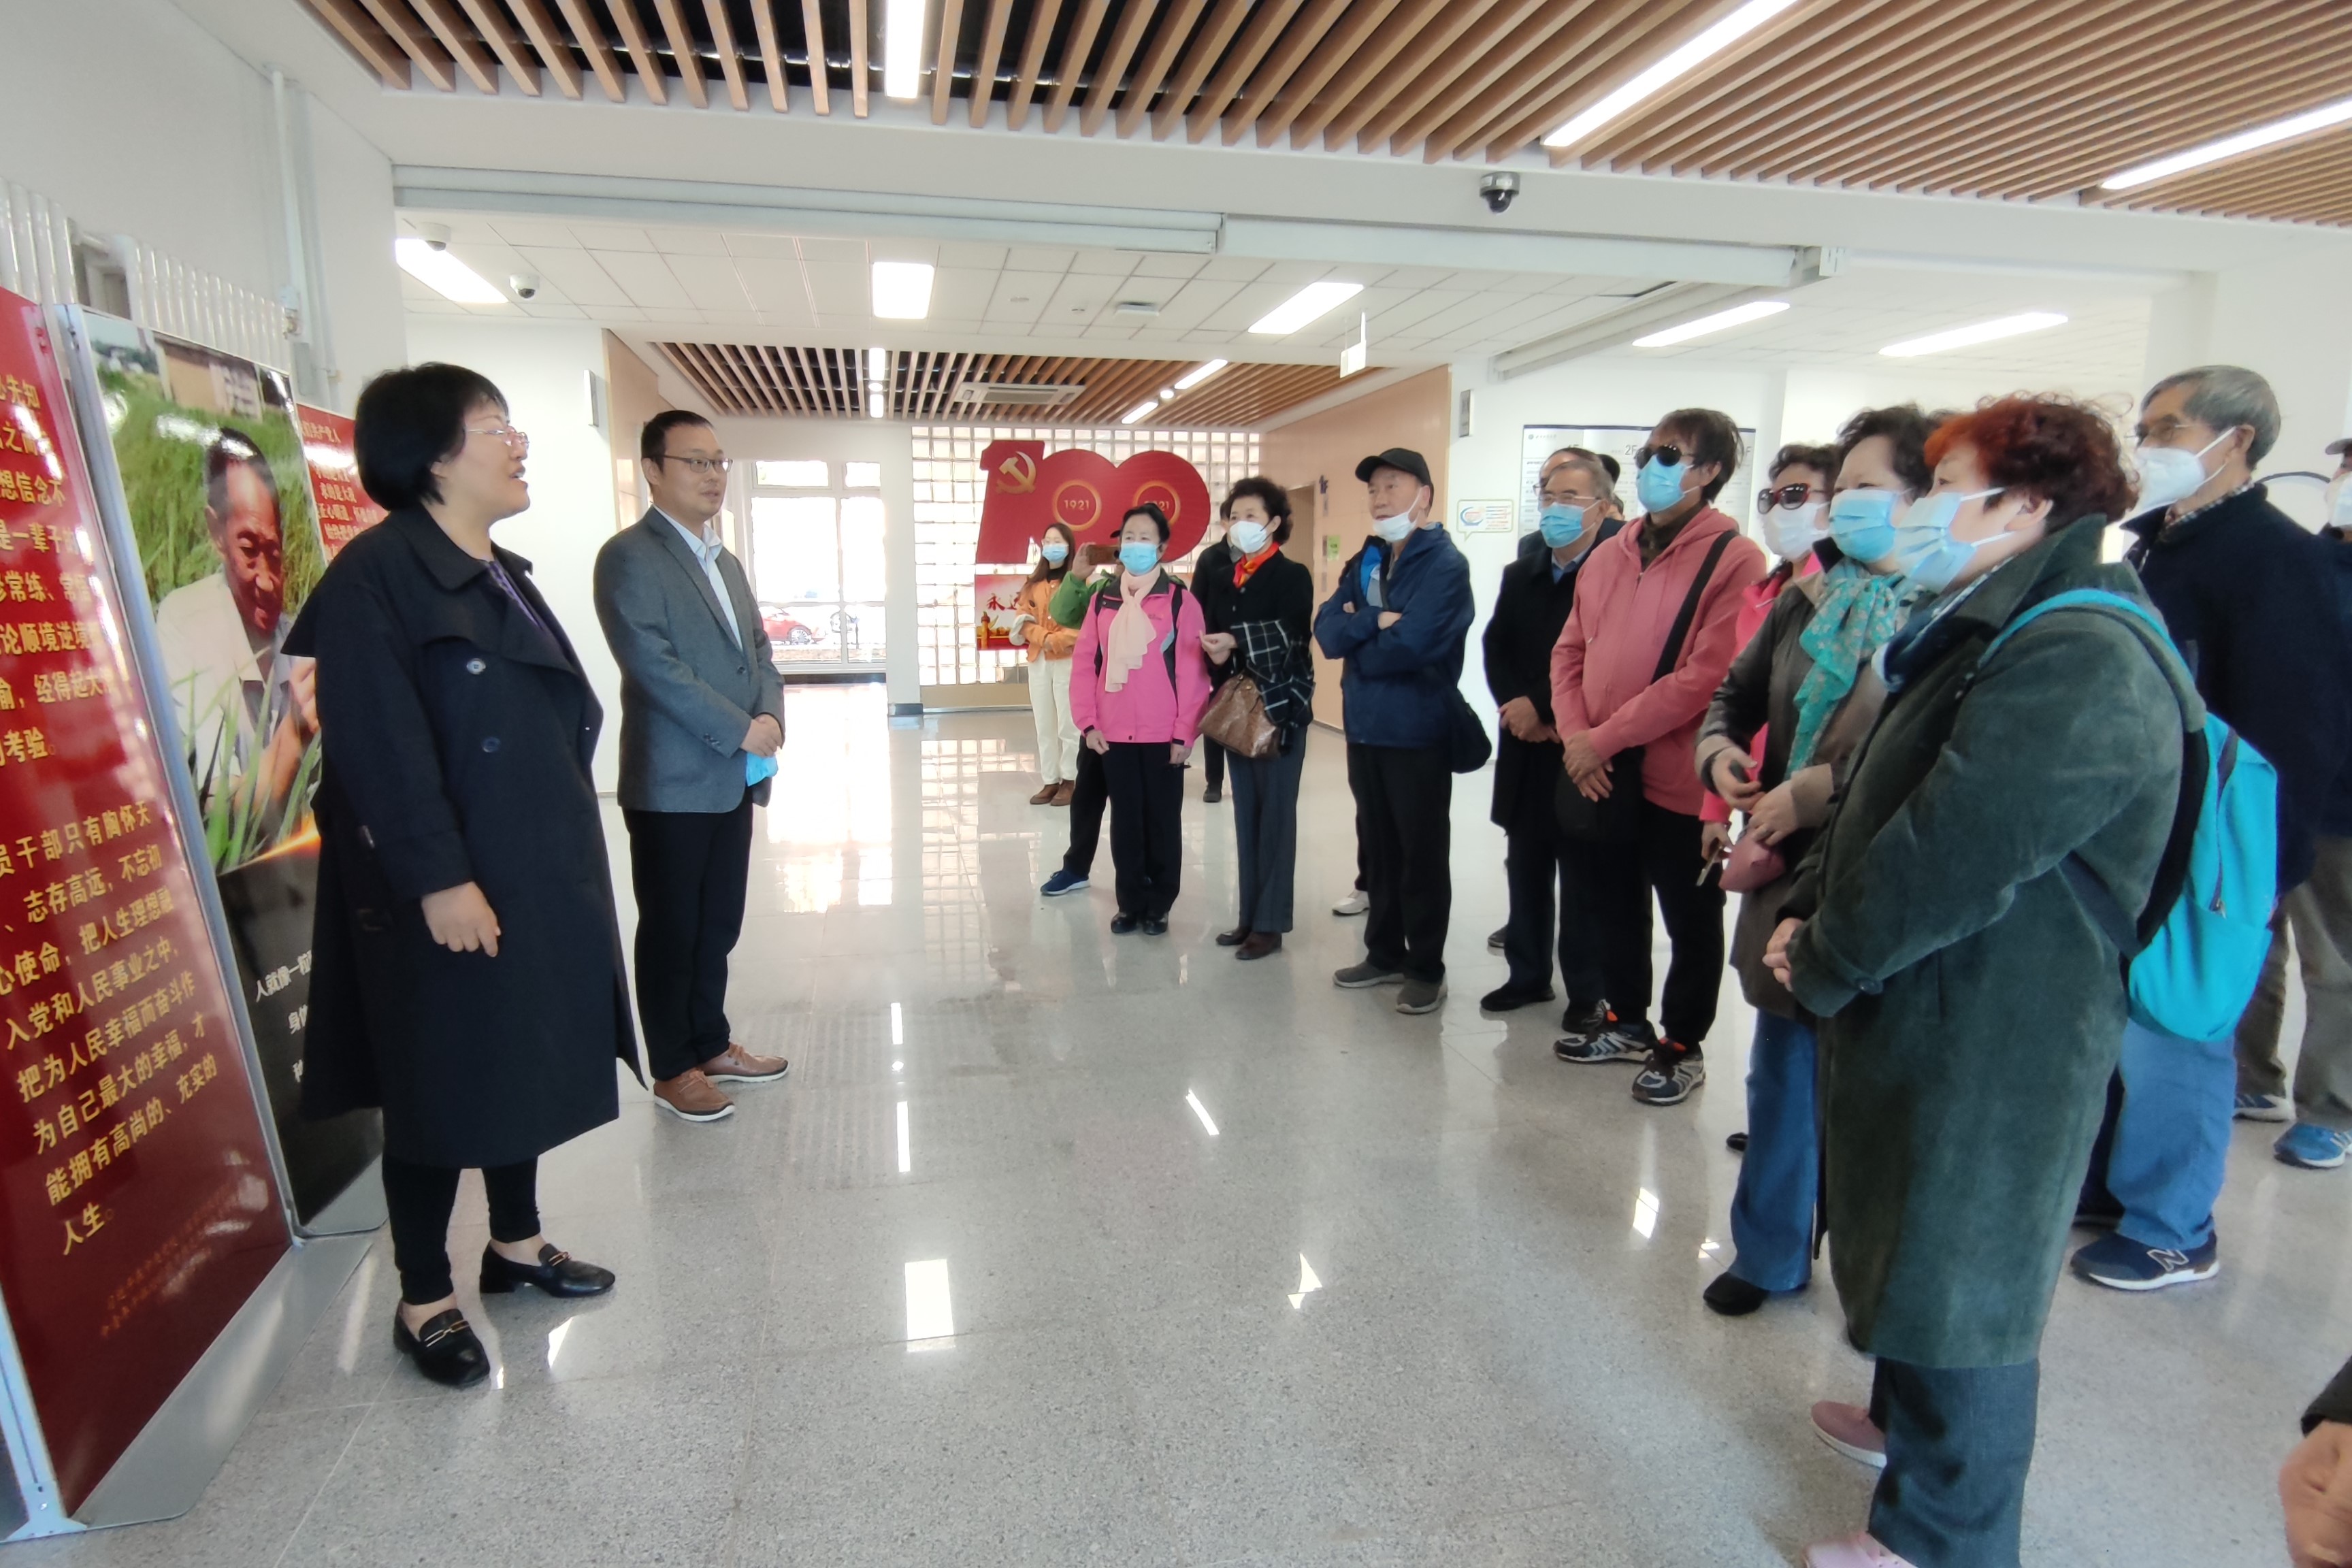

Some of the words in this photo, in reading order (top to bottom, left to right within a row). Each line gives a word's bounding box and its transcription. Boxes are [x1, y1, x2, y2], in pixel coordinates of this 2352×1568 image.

[1064, 500, 1090, 510] 1921
[0, 621, 102, 655] 论顺境逆境
[0, 726, 55, 763] 考验。
[17, 970, 196, 1104] 把为人民幸福而奋斗作
[46, 1053, 218, 1206] 能拥有高尚的、充实的
